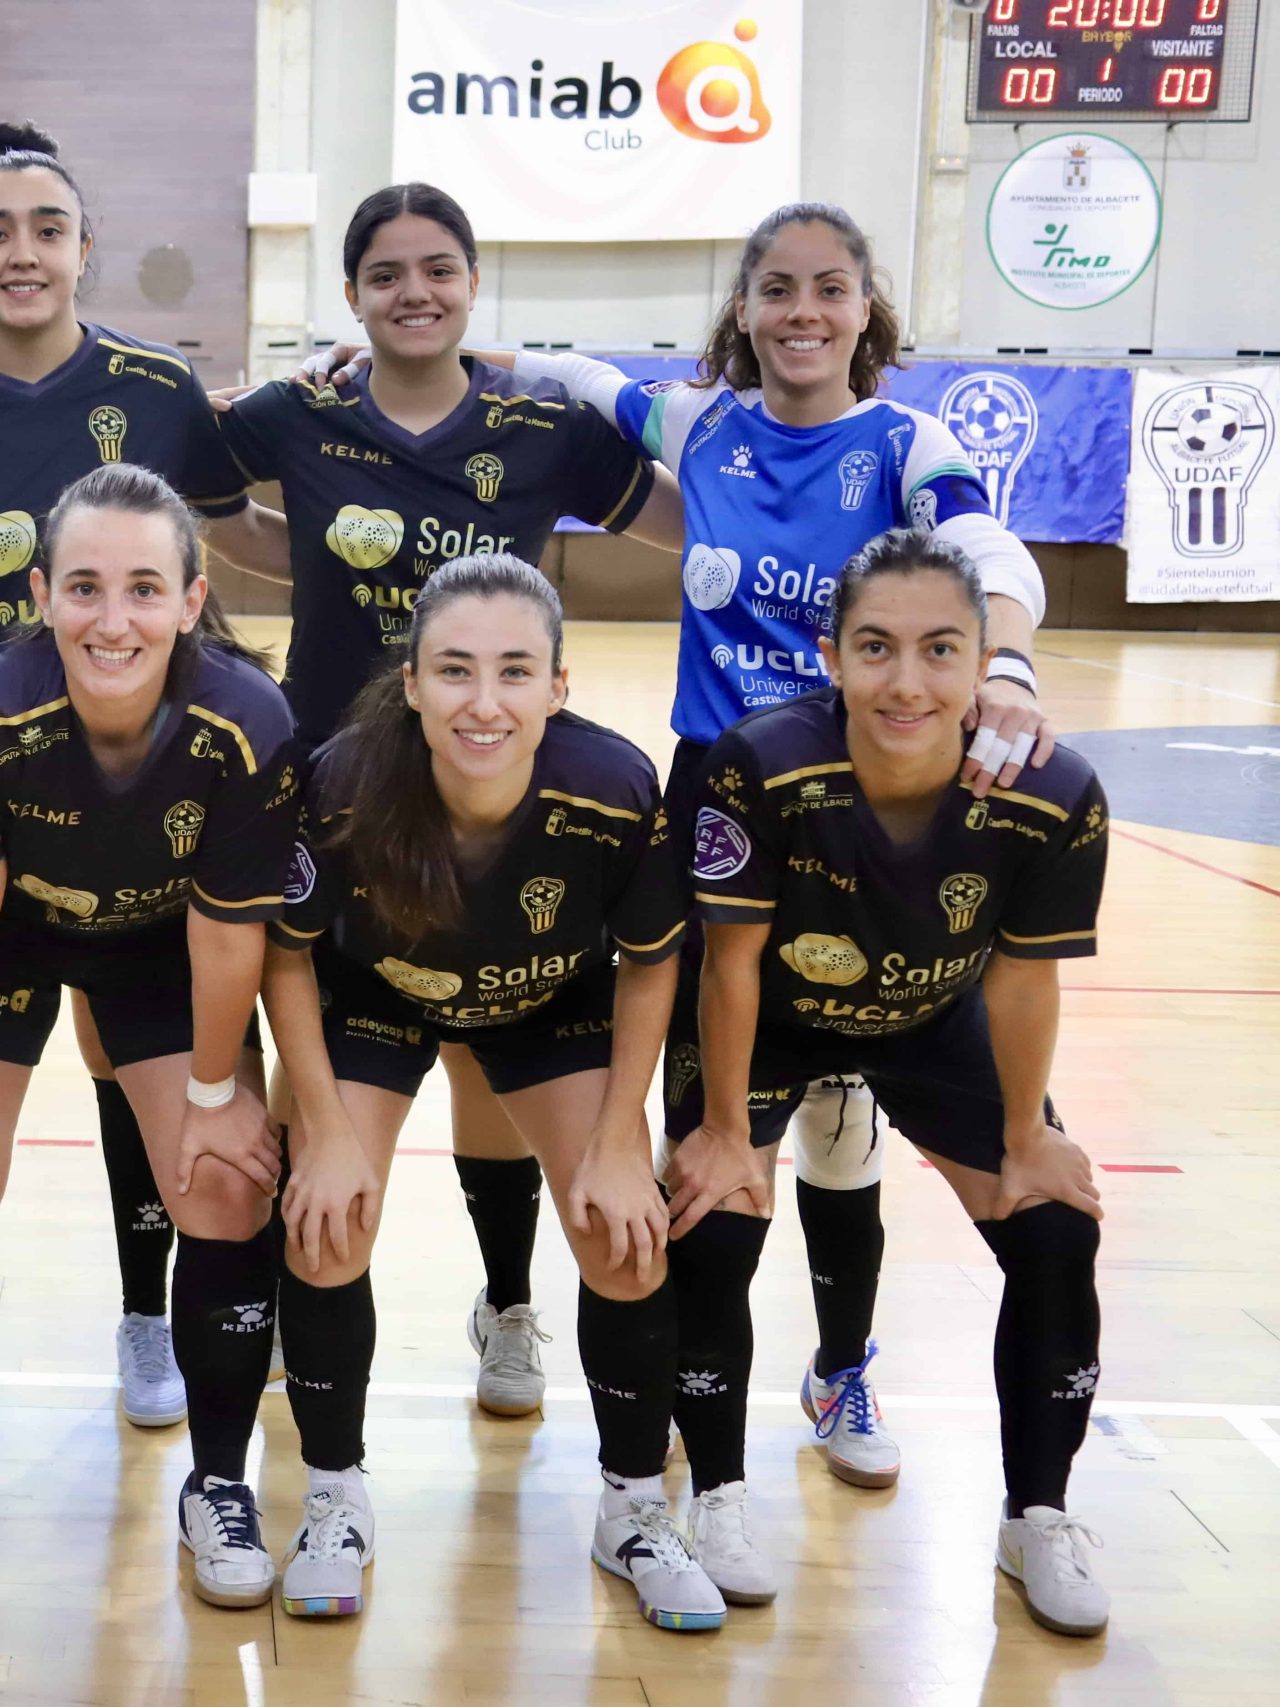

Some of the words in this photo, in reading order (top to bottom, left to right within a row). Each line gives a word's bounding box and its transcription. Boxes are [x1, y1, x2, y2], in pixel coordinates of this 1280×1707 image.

[1048, 0, 1166, 28] 20:00
[987, 25, 1019, 36] FALTAS
[1190, 25, 1223, 36] FALTAS
[995, 42, 1057, 58] LOCAL
[1152, 40, 1214, 56] VISITANTE
[1100, 58, 1112, 82] 1
[407, 59, 642, 119] amiab
[1004, 68, 1056, 103] 00
[1159, 68, 1212, 103] 00
[1078, 87, 1123, 102] PERIODO
[584, 129, 642, 151] Club
[1010, 195, 1078, 204] AYUNTAMIENTO
[1095, 196, 1140, 204] ALBACETE
[1048, 271, 1084, 279] MUNICIPAL
[321, 442, 393, 465] KELME
[720, 466, 757, 479] KELME
[1174, 467, 1243, 483] UDAF
[417, 517, 510, 556] Solar
[754, 556, 836, 607] Sola
[1157, 567, 1255, 580] #Sientelaunion
[375, 587, 419, 610] UC
[751, 598, 799, 621] World
[803, 610, 832, 630] Sta
[8, 800, 82, 825] KELME
[788, 855, 857, 893] KELME
[532, 903, 555, 913] UDAF
[952, 903, 974, 913] UDAF
[478, 952, 583, 991] Solar
[881, 951, 978, 987] Solar
[479, 984, 529, 1002] World
[347, 1016, 404, 1039] adeycap
[555, 1018, 614, 1038] KELM
[747, 1089, 773, 1102] ycap
[132, 1220, 169, 1231] KELME
[287, 1373, 333, 1390] ELME
[590, 1380, 637, 1400] ELME
